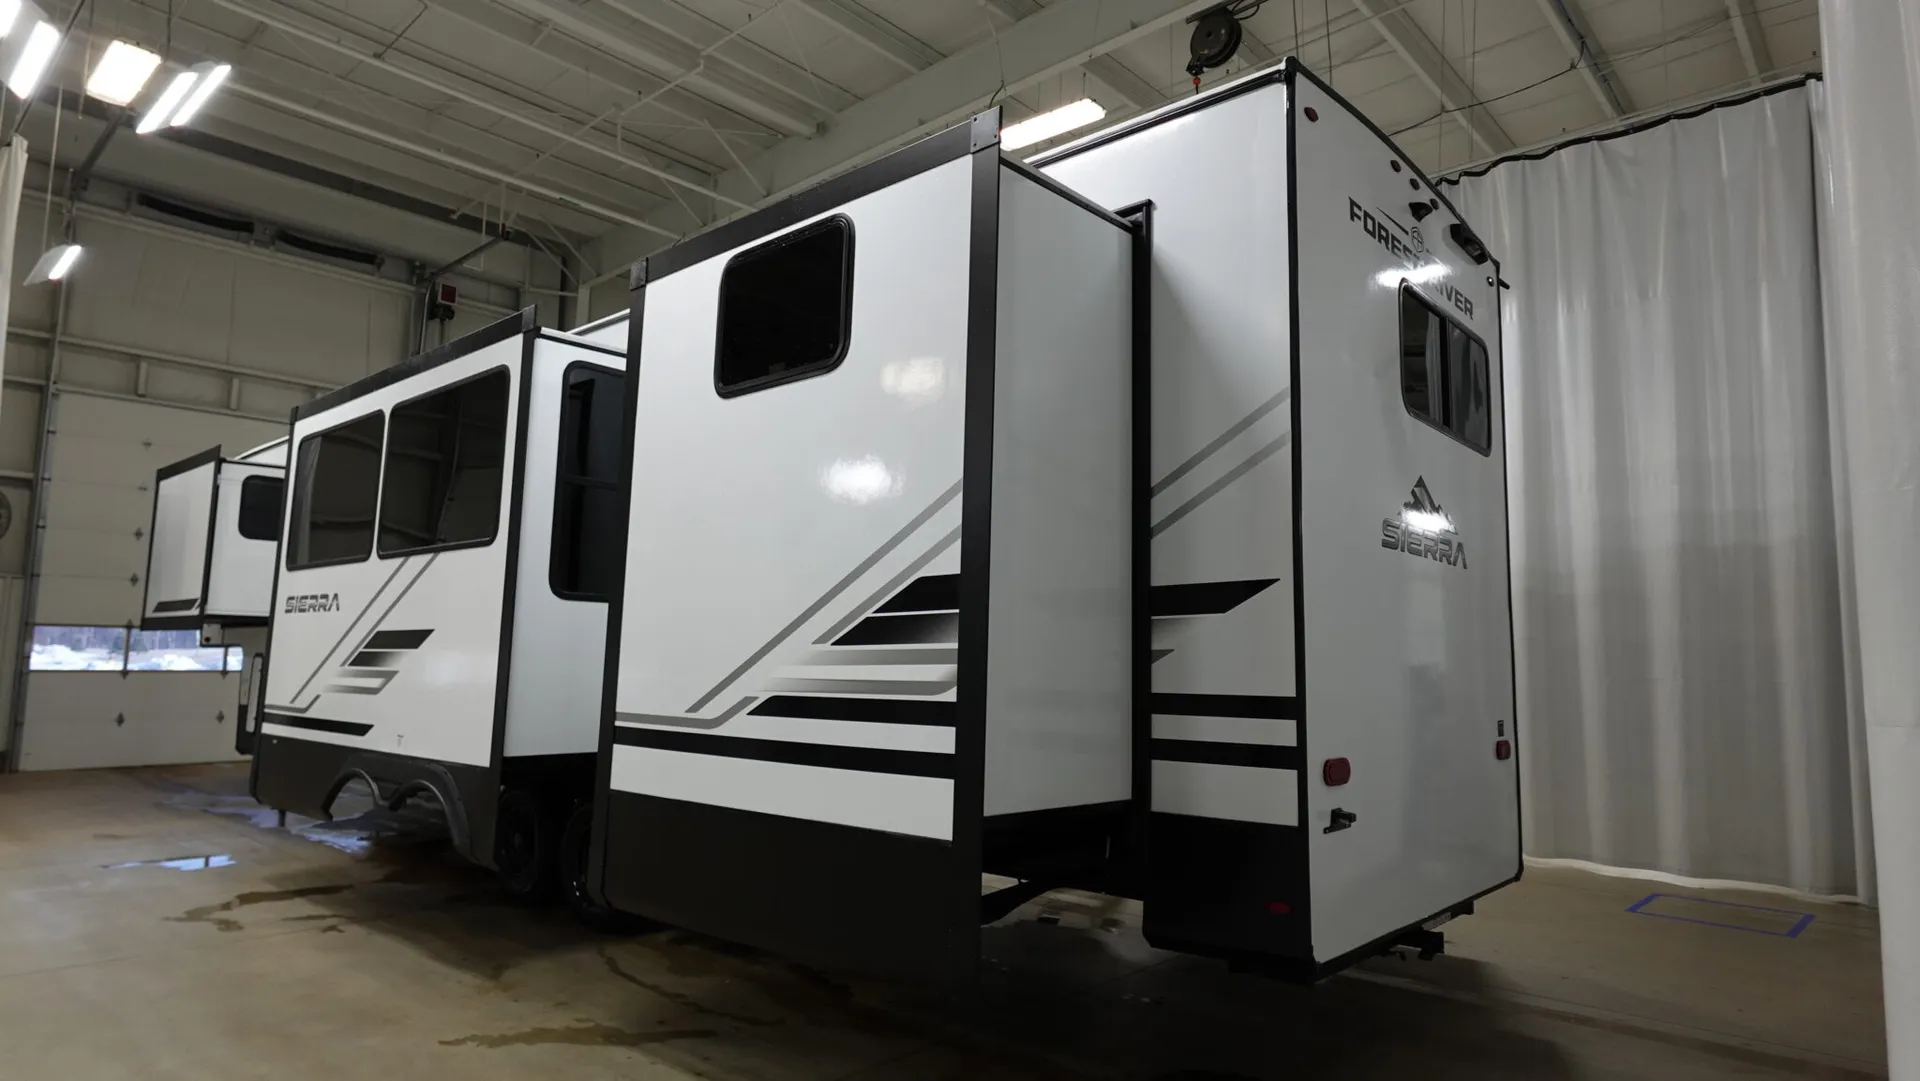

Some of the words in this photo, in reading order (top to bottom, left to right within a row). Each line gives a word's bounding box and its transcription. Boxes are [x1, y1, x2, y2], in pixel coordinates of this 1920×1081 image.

[1428, 267, 1475, 321] IVER
[1381, 517, 1468, 570] SIERRA
[284, 592, 341, 614] SIERRA
